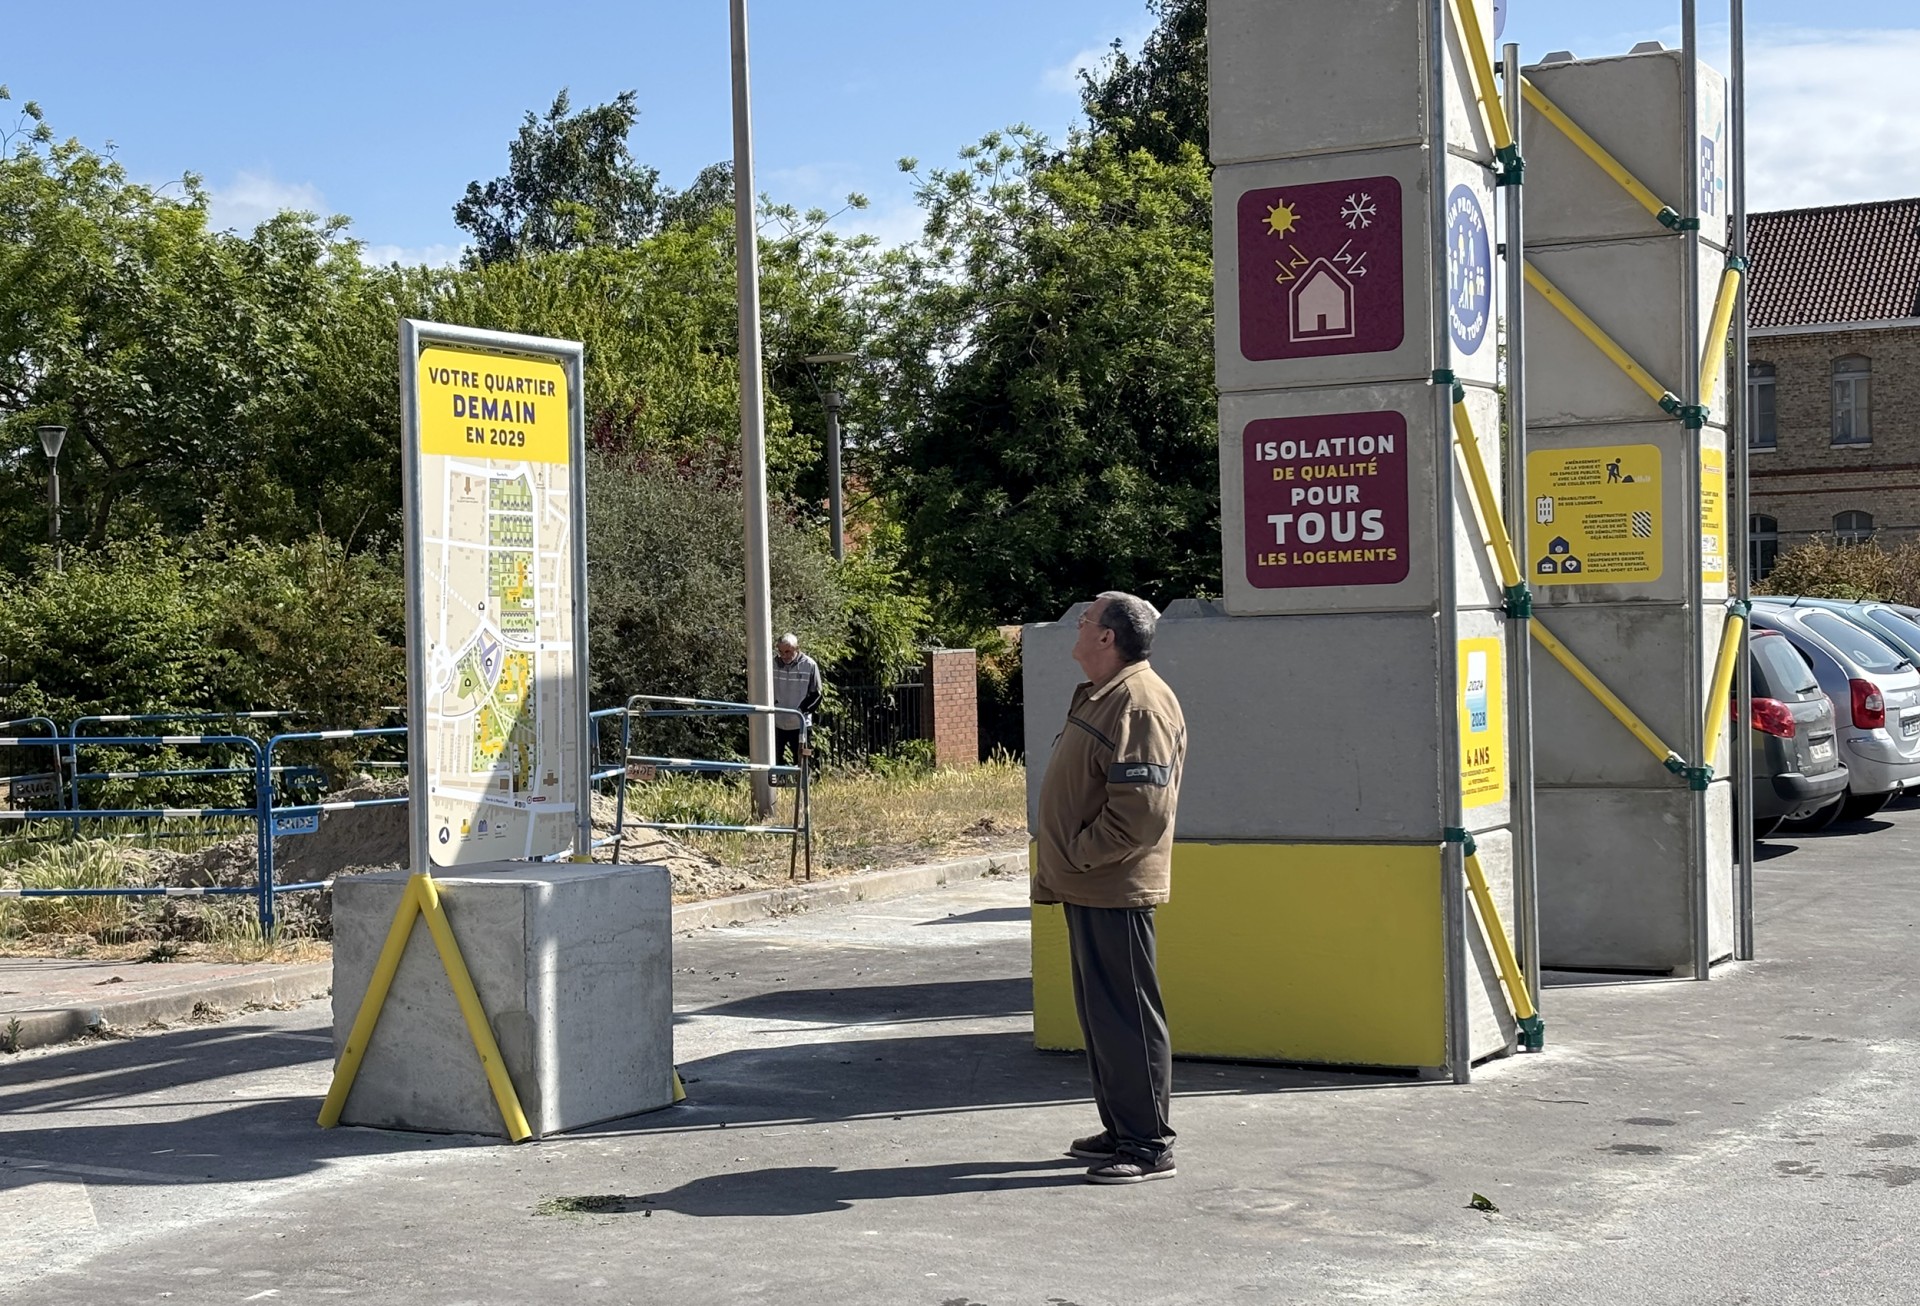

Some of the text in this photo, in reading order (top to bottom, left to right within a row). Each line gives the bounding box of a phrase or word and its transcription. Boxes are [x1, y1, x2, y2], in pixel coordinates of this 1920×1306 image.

[1457, 196, 1482, 233] PROJET
[1467, 311, 1483, 341] TOUS
[429, 367, 556, 397] VOTRE QUARTIER
[453, 394, 536, 425] DEMAIN
[466, 426, 525, 447] EN 2029
[1255, 434, 1395, 461] ISOLATION
[1273, 456, 1378, 481] DE QUALITÉ
[1290, 485, 1361, 506] POUR
[1267, 509, 1385, 545] TOUS
[1258, 548, 1397, 566] LES LOGEMENTS
[1466, 746, 1490, 767] 4 ANS
[276, 815, 314, 830] SADE
